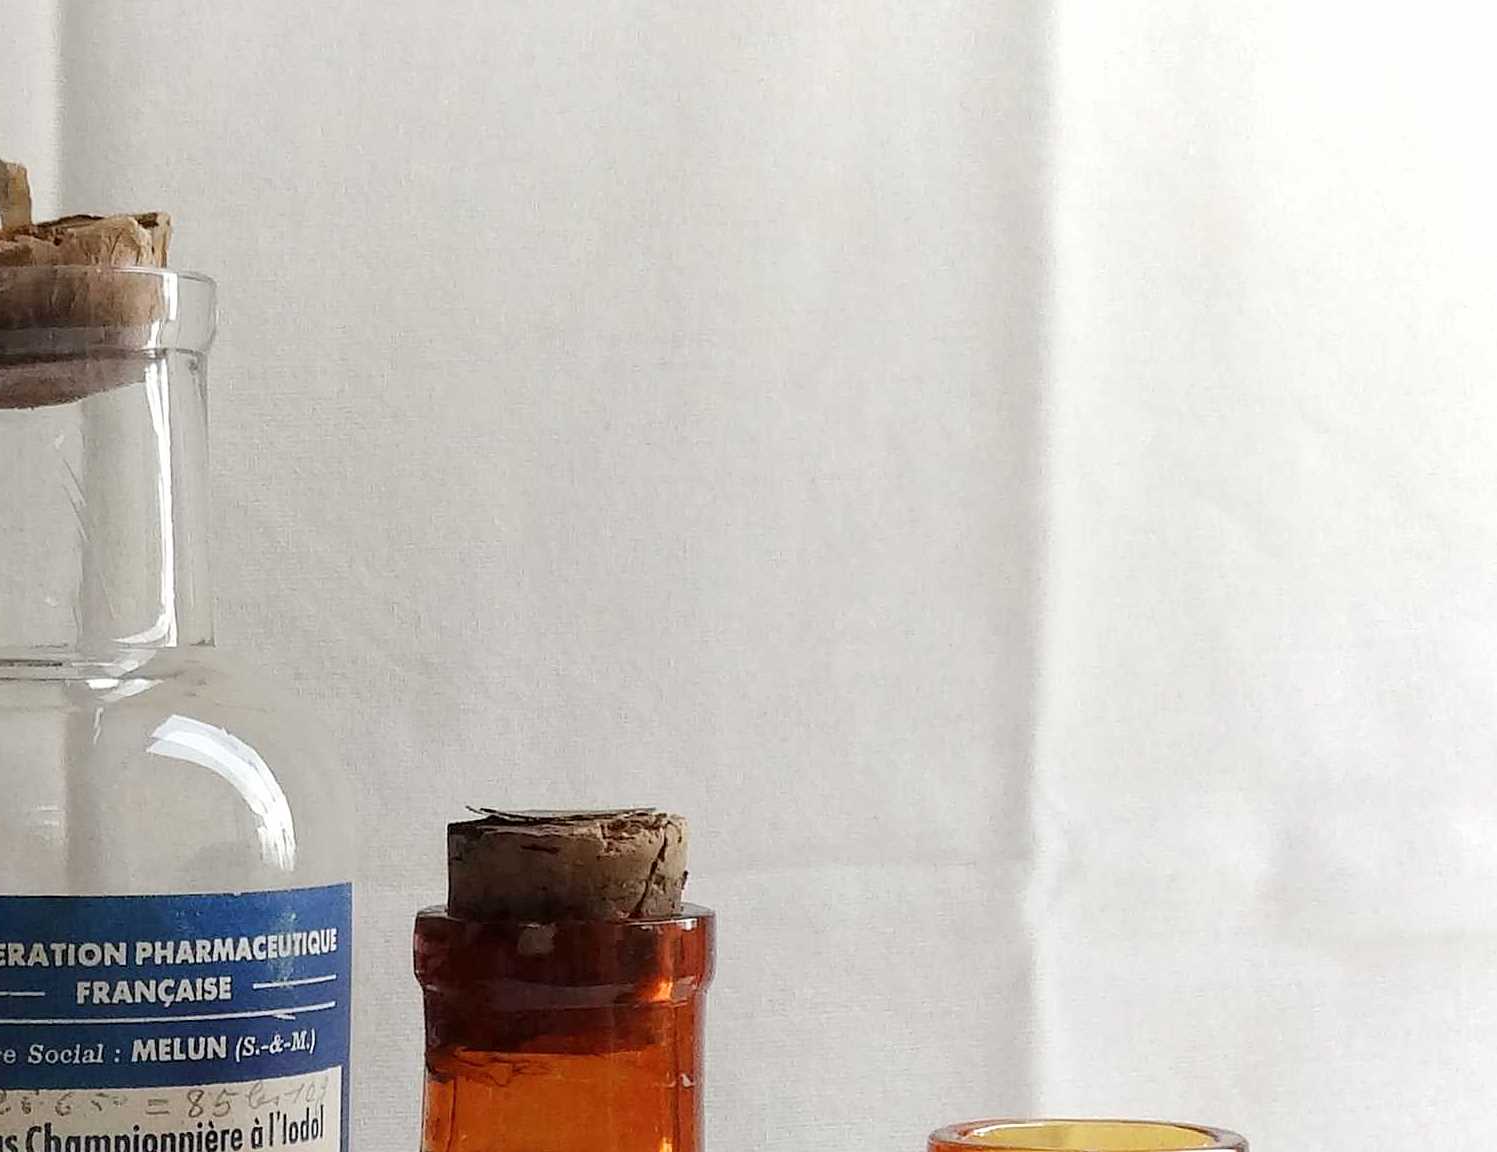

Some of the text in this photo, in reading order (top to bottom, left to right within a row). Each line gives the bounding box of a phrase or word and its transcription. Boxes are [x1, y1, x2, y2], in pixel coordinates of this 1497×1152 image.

[135, 928, 337, 965] PHARMACEUTIQUE
[76, 975, 232, 1009] FRANÇAISE
[27, 1043, 104, 1064] Social
[131, 1036, 227, 1063] MELUN
[251, 1117, 264, 1149] à
